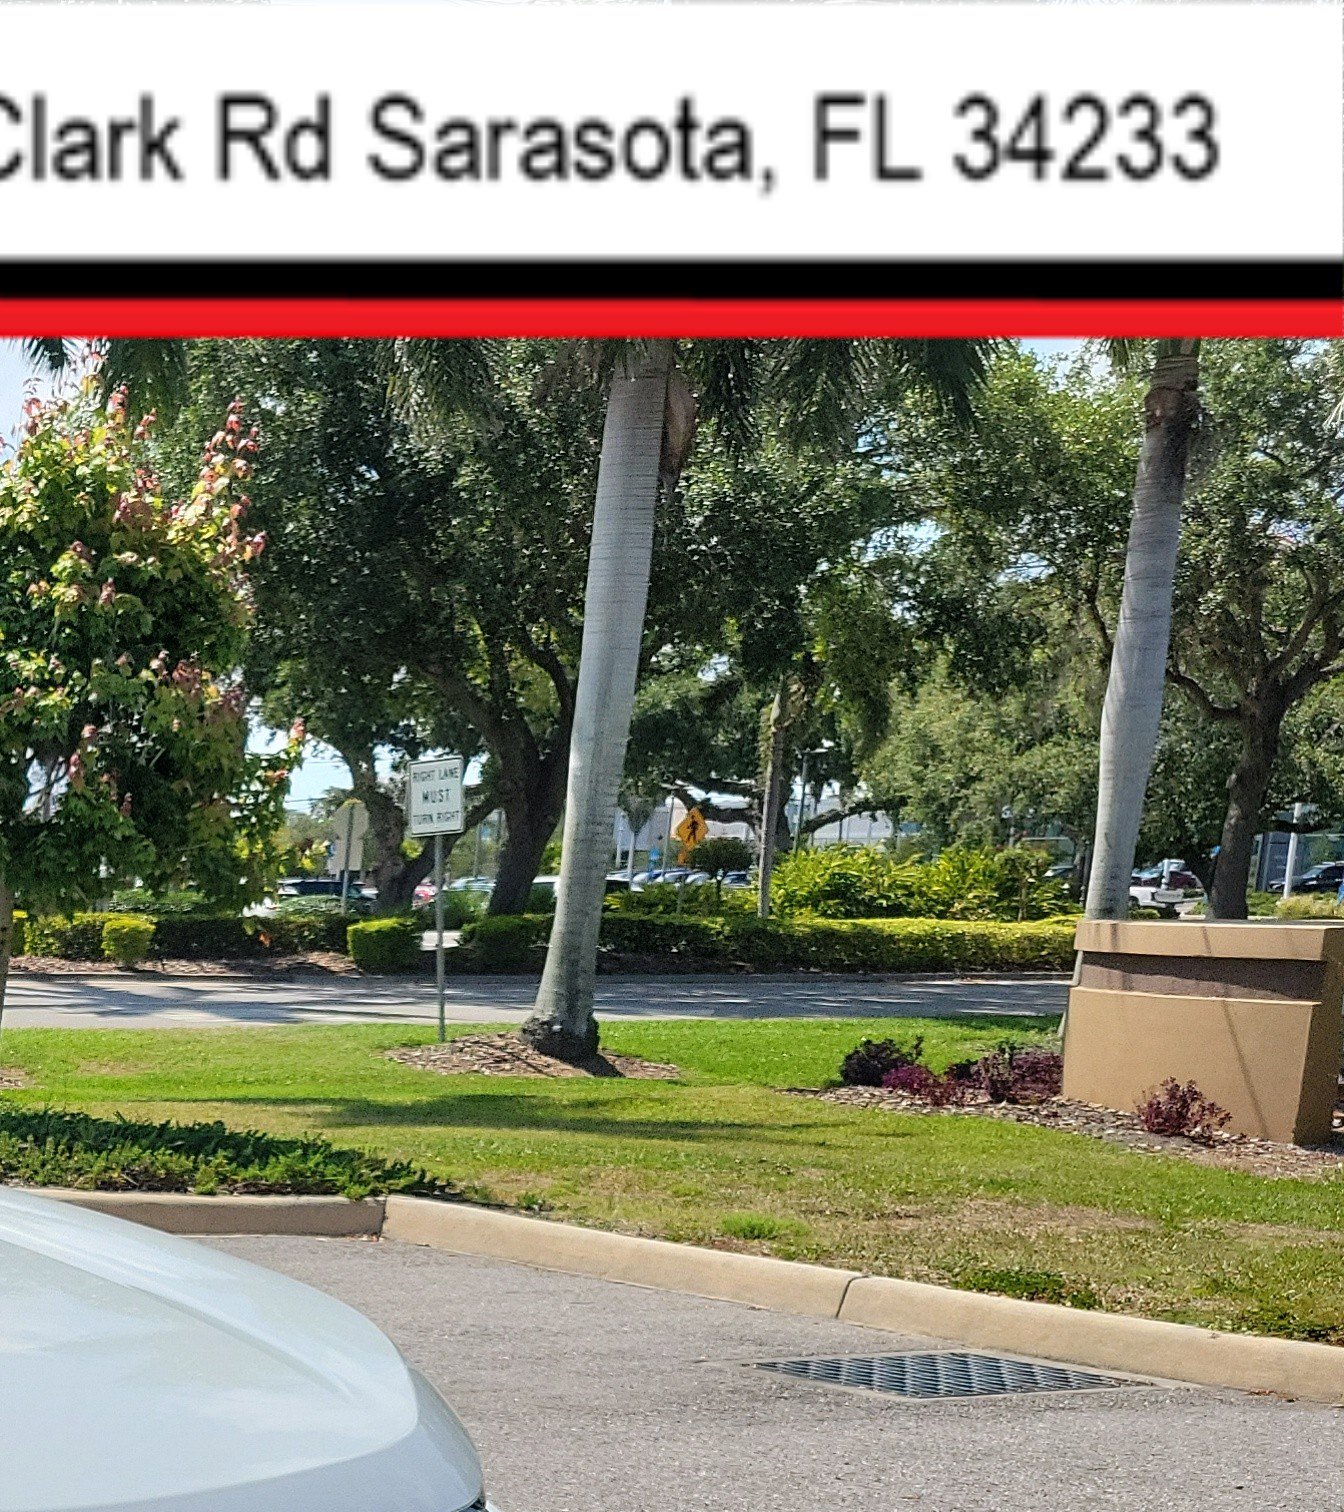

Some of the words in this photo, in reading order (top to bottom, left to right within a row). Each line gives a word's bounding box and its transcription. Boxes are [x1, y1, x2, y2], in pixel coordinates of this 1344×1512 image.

[413, 769, 435, 782] RIGHT
[438, 766, 459, 780] LANE
[422, 788, 450, 803] MUST
[413, 813, 433, 825] TURN
[437, 810, 459, 823] RIGHT
